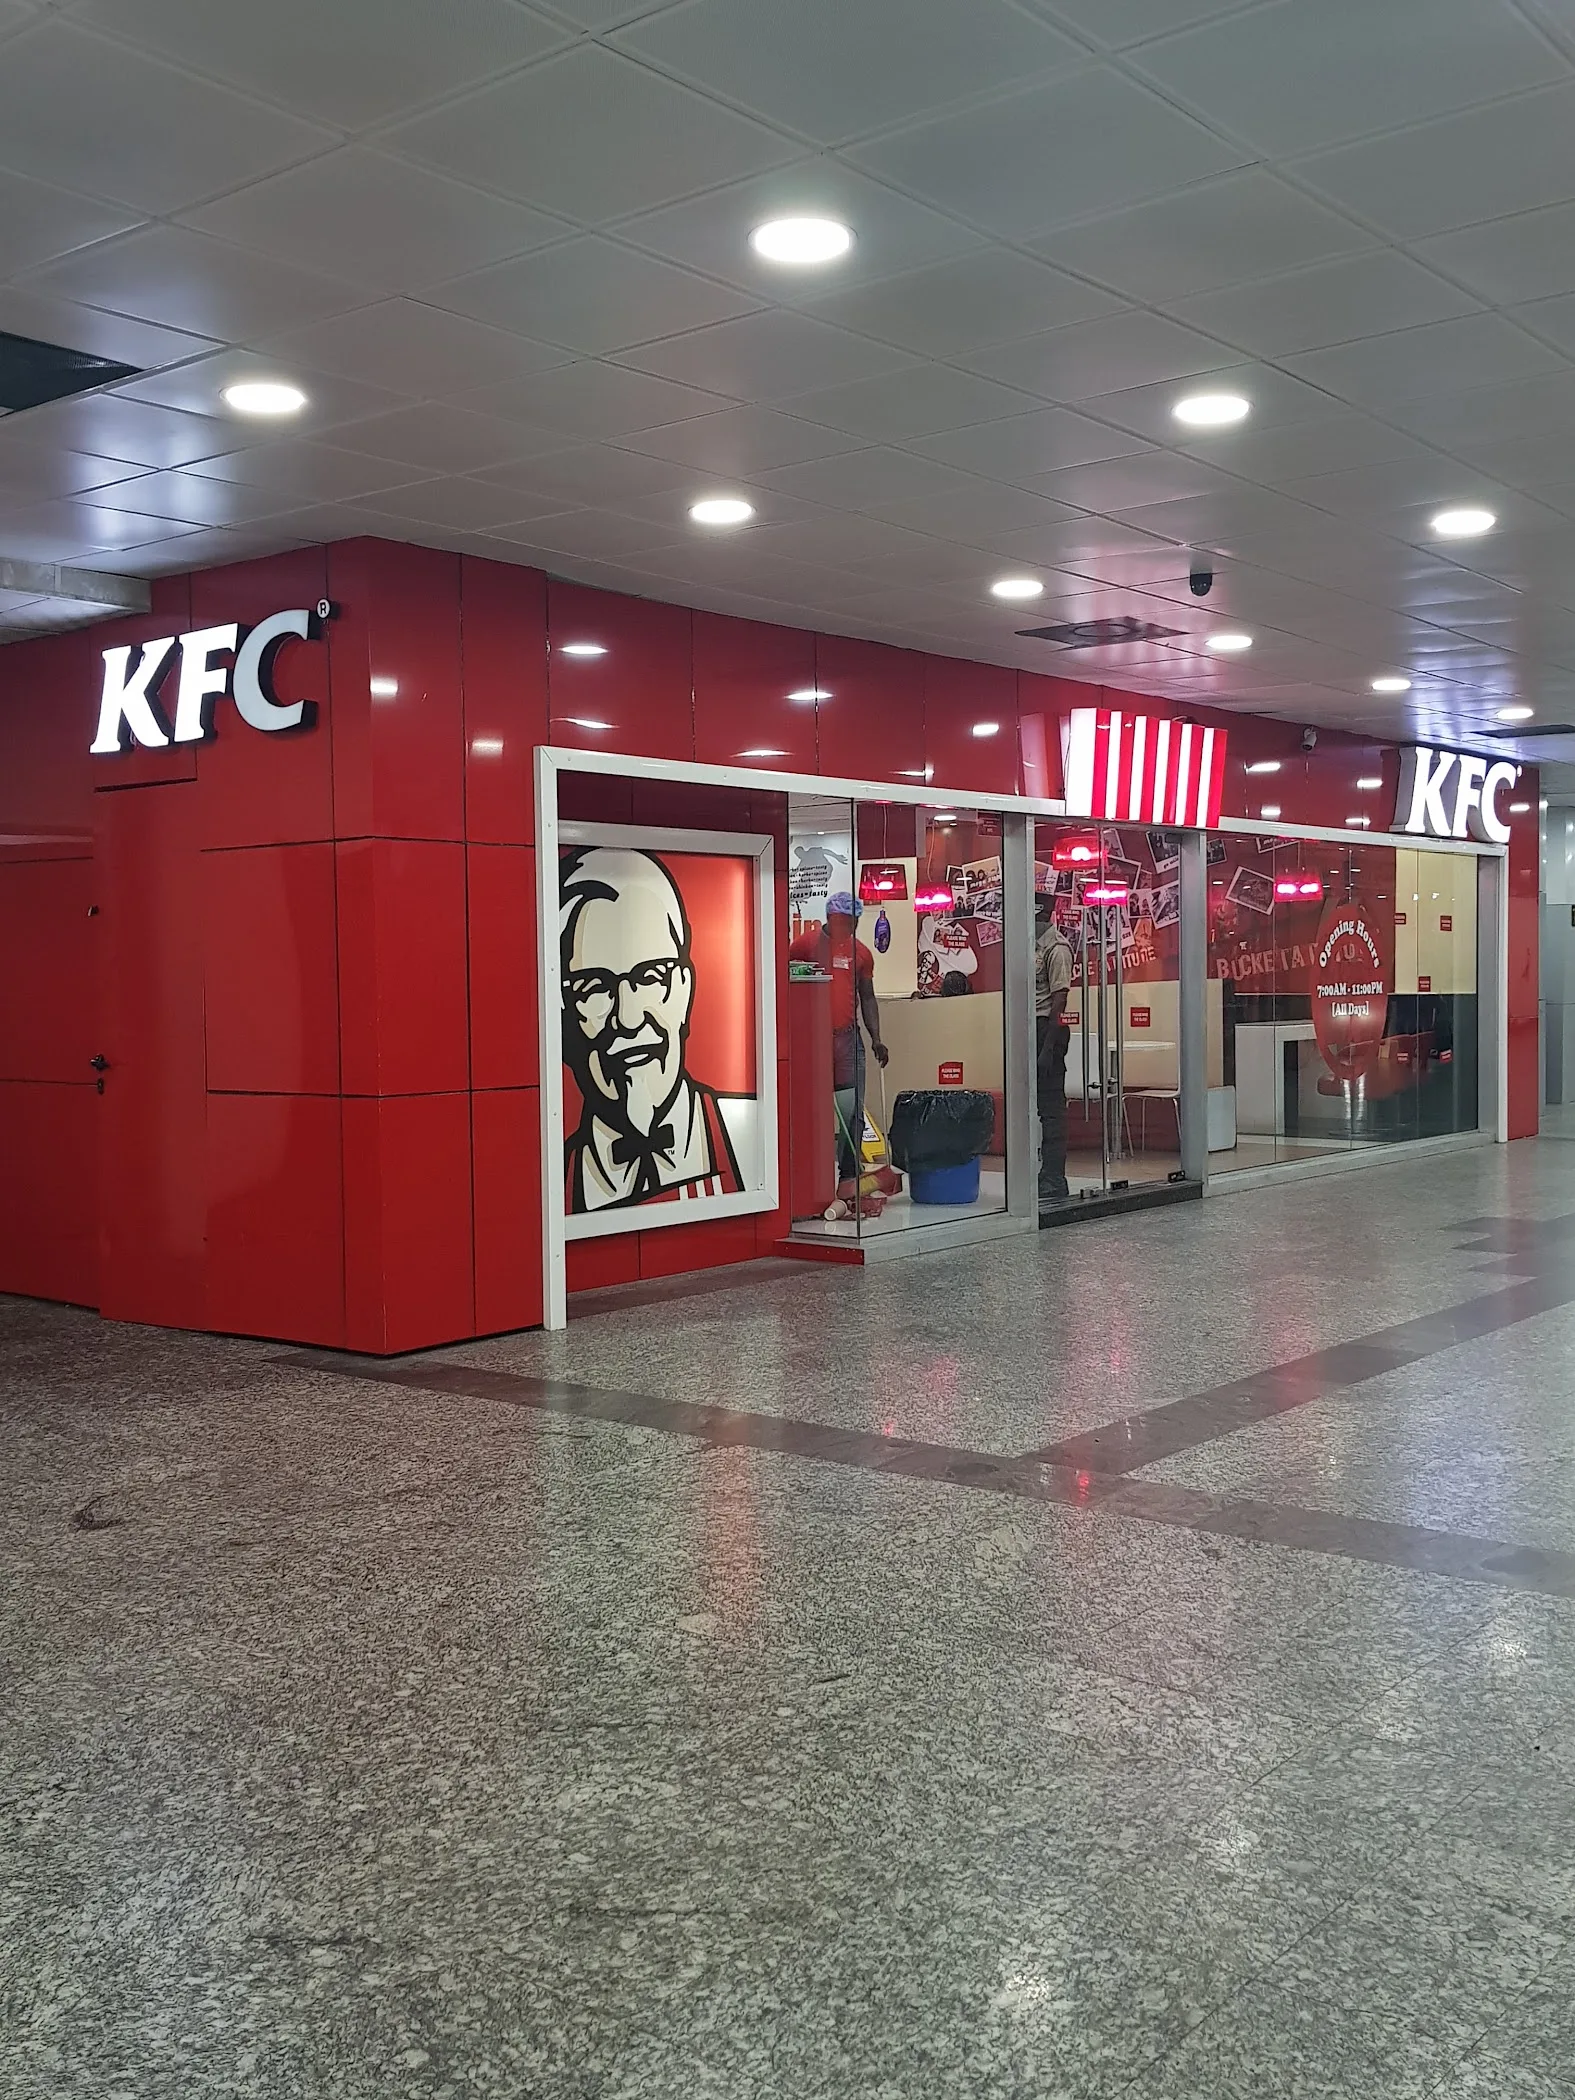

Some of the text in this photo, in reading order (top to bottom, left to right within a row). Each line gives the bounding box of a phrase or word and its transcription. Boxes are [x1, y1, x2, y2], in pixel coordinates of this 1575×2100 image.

[89, 608, 313, 755] KFC
[1404, 746, 1517, 843] KFC
[1319, 920, 1380, 968] Opening Hours
[1317, 983, 1347, 998] 7:00AM
[1352, 981, 1383, 995] 11:00PM
